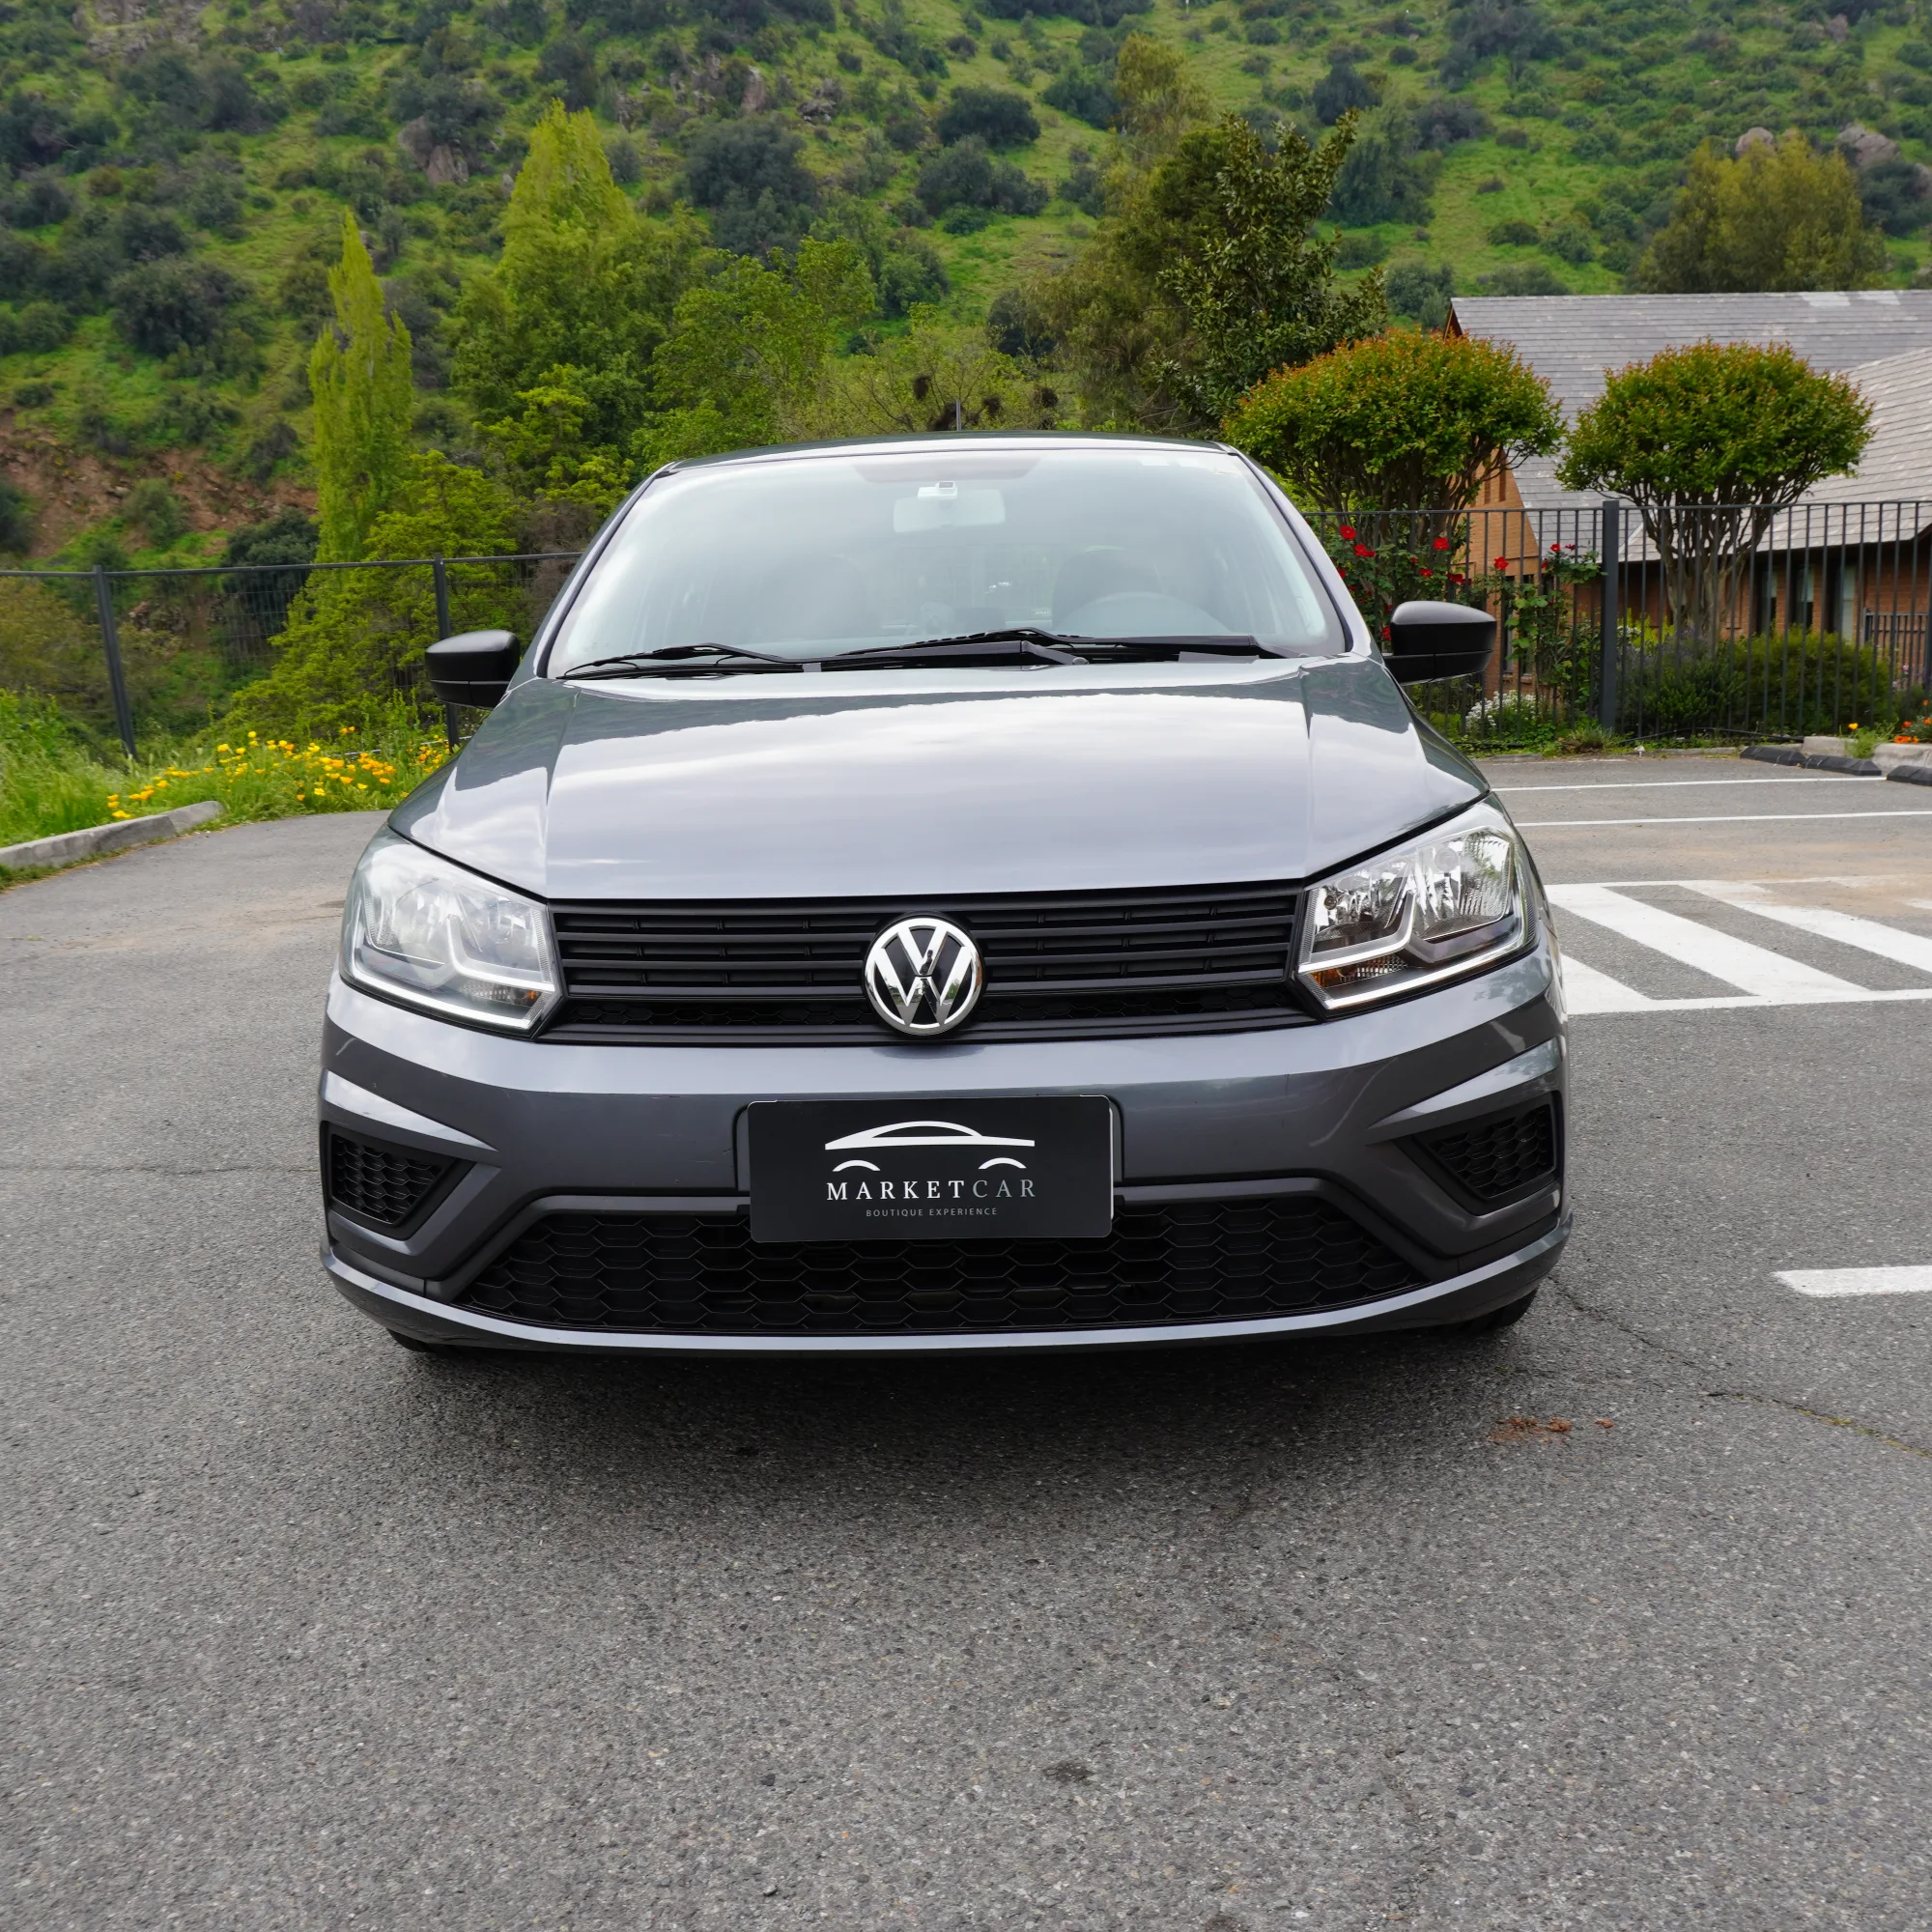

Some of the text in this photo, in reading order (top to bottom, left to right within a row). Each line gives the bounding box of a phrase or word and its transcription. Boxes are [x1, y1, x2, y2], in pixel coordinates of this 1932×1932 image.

[826, 1179, 1037, 1201] MARKETCAR
[866, 1208, 998, 1218] BOUTIQUE EXPERIENCE
